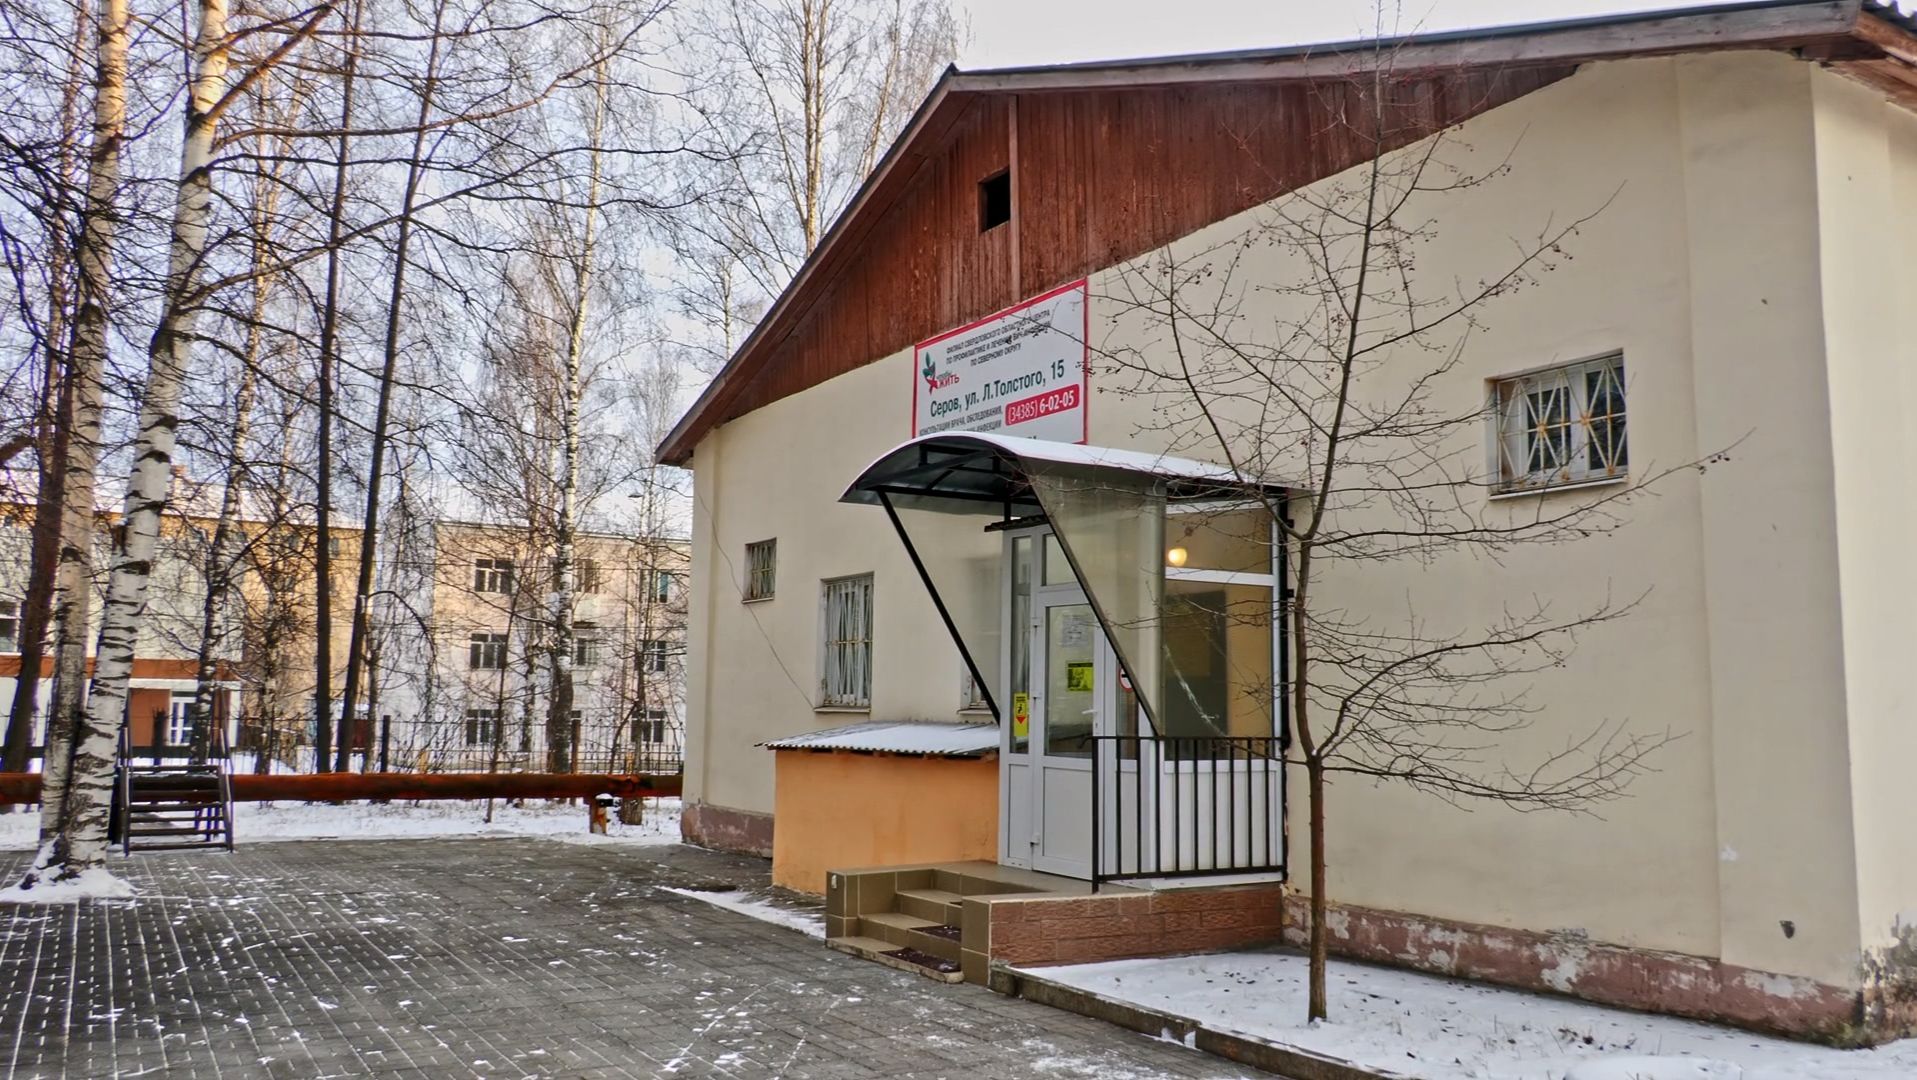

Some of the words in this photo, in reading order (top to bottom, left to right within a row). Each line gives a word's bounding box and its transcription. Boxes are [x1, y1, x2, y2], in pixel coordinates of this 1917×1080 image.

[930, 397, 962, 417] Серов,
[964, 392, 980, 410] ул.
[1050, 359, 1064, 380] 15
[1008, 400, 1038, 424] (34385)
[1040, 390, 1074, 413] 6-02-05
